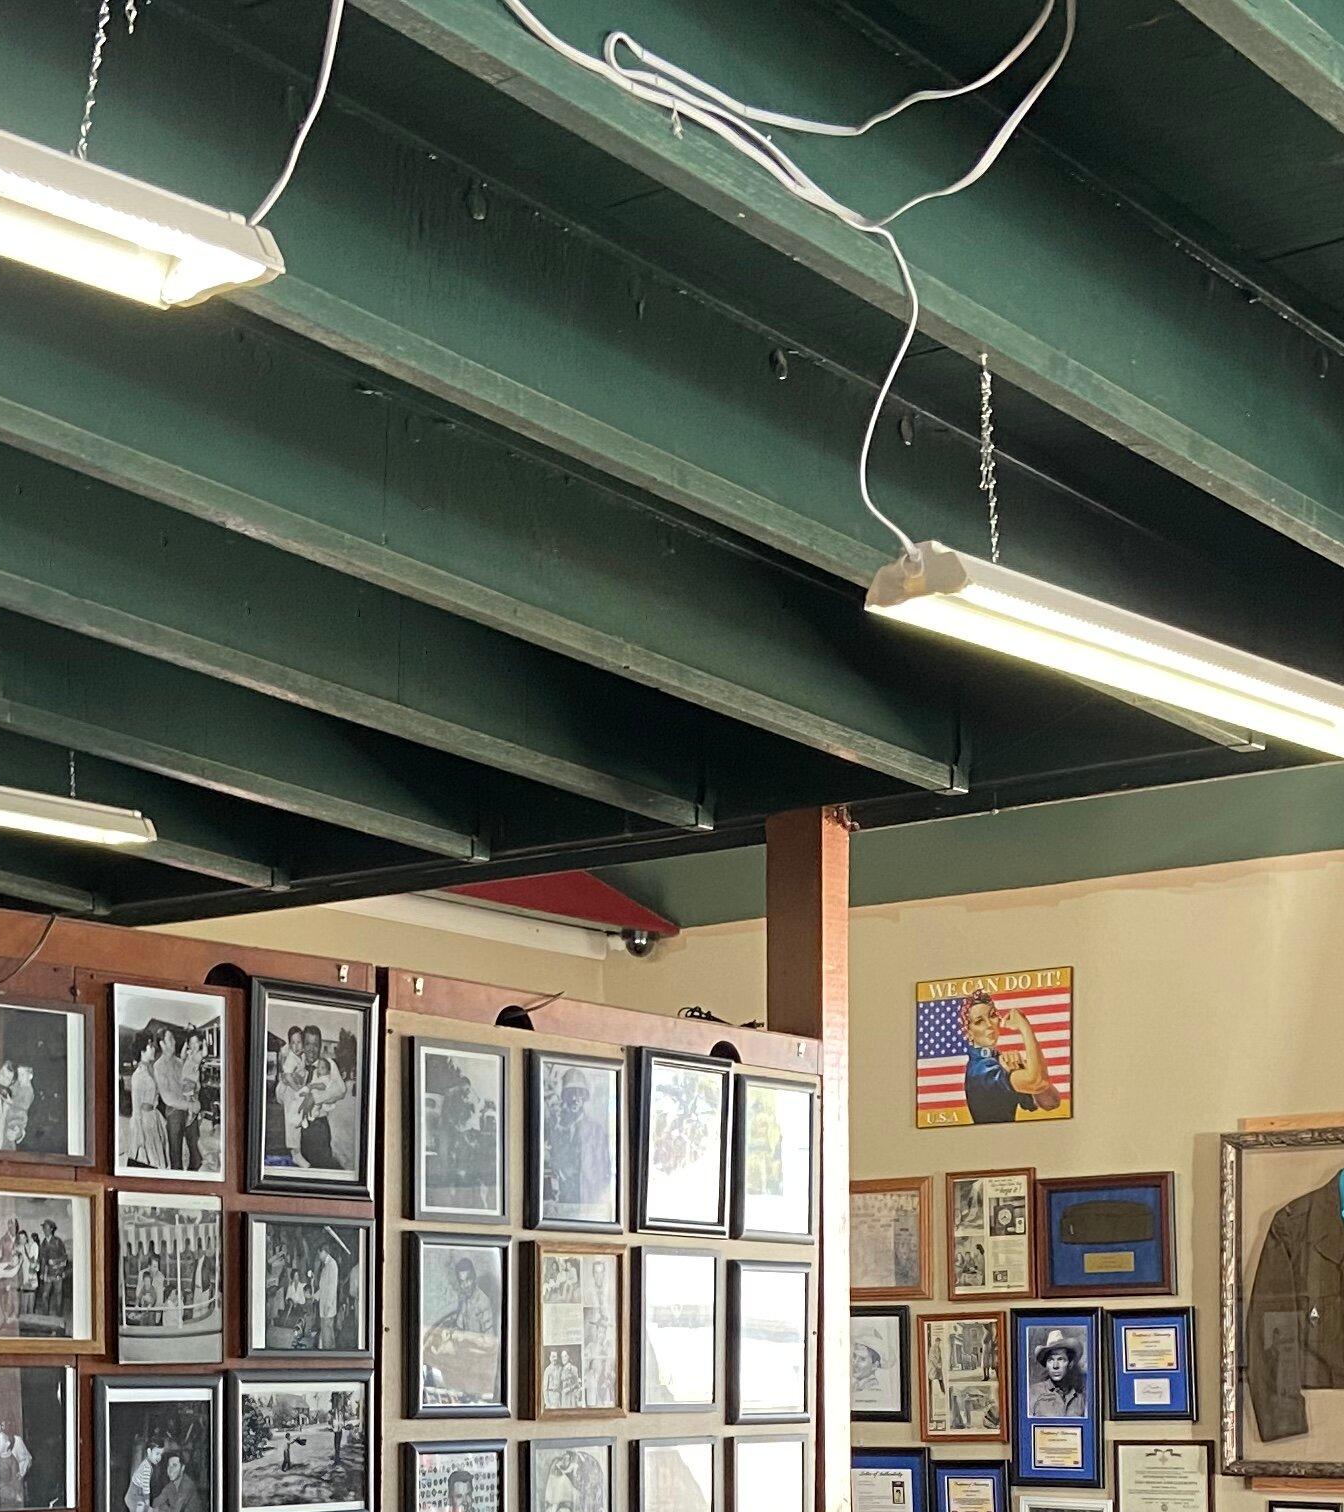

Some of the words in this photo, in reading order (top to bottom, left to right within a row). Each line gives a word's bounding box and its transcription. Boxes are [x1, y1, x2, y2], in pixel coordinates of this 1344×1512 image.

[928, 981, 957, 998] WE
[962, 977, 1000, 996] CAN
[1006, 974, 1032, 991] DO
[1037, 970, 1062, 988] IT!
